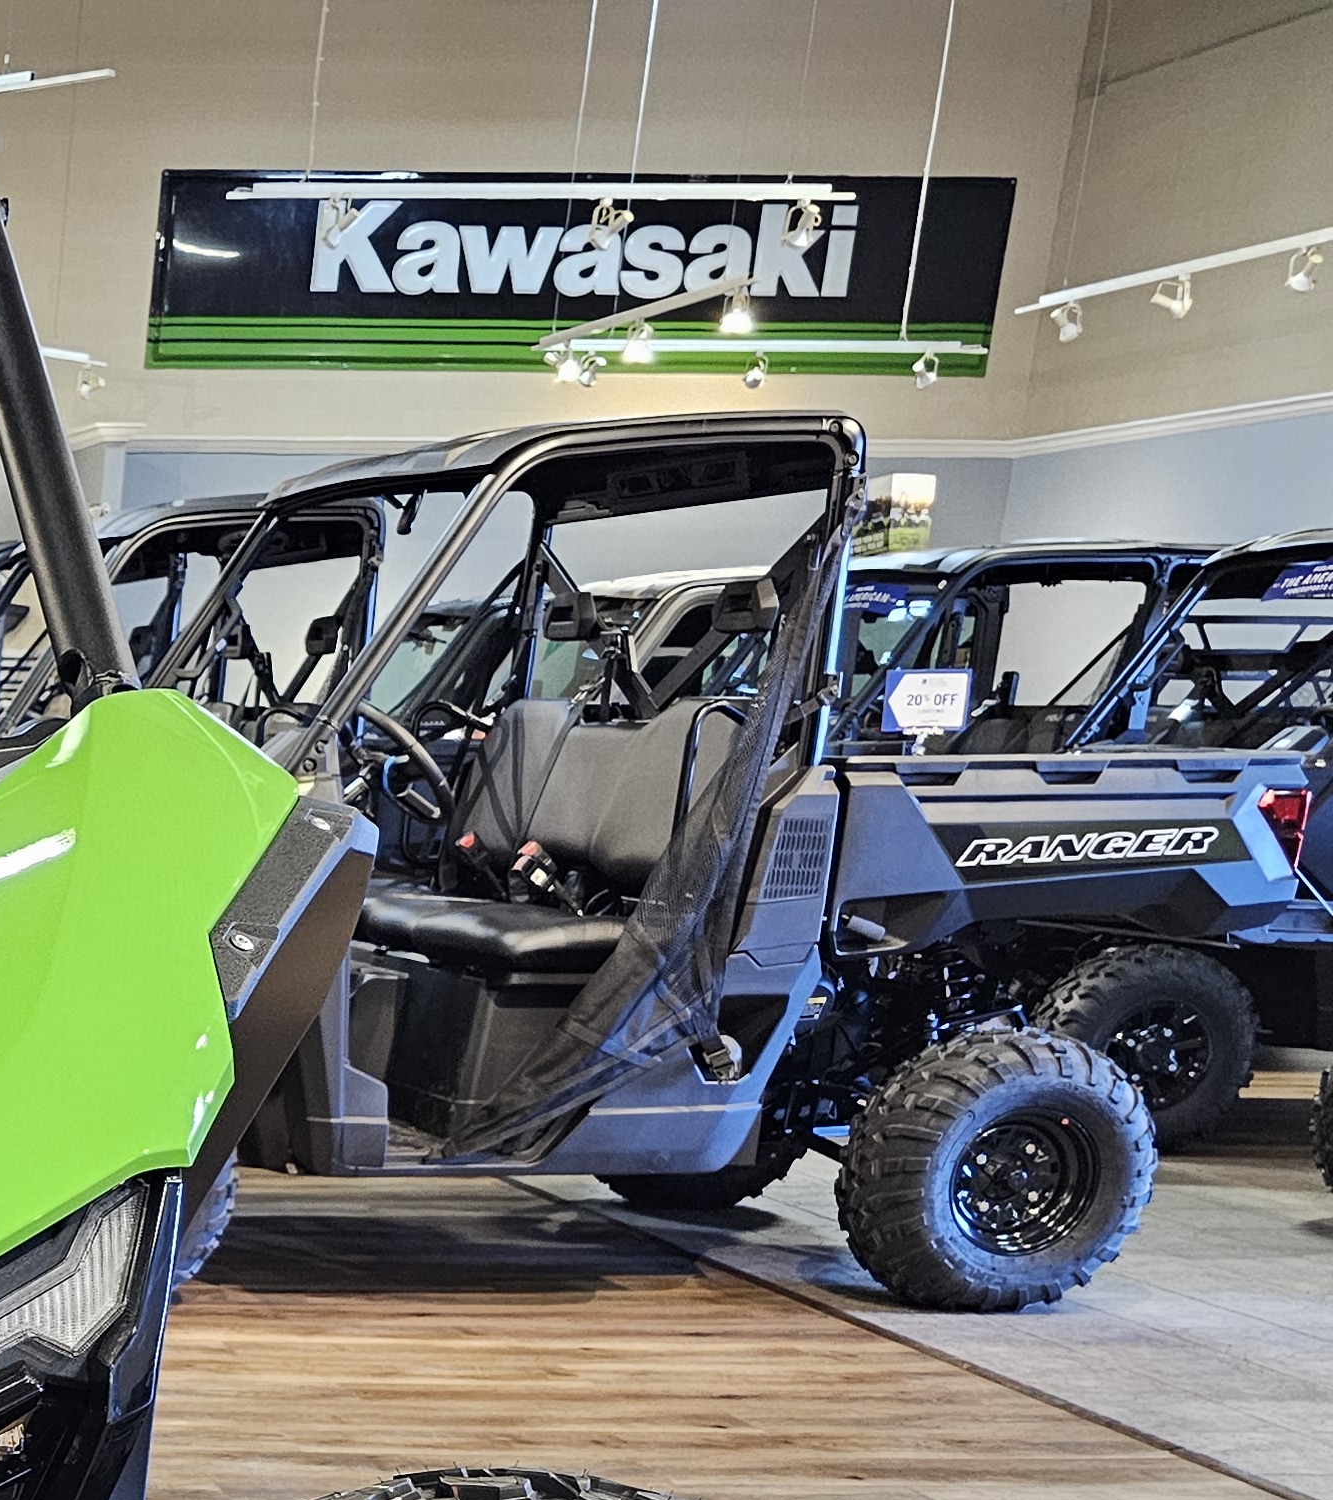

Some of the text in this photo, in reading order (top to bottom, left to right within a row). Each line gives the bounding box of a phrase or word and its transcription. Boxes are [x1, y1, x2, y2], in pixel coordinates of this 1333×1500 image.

[309, 199, 859, 299] Kawasaki
[933, 693, 959, 706] OFF
[954, 826, 1220, 868] RANGER
